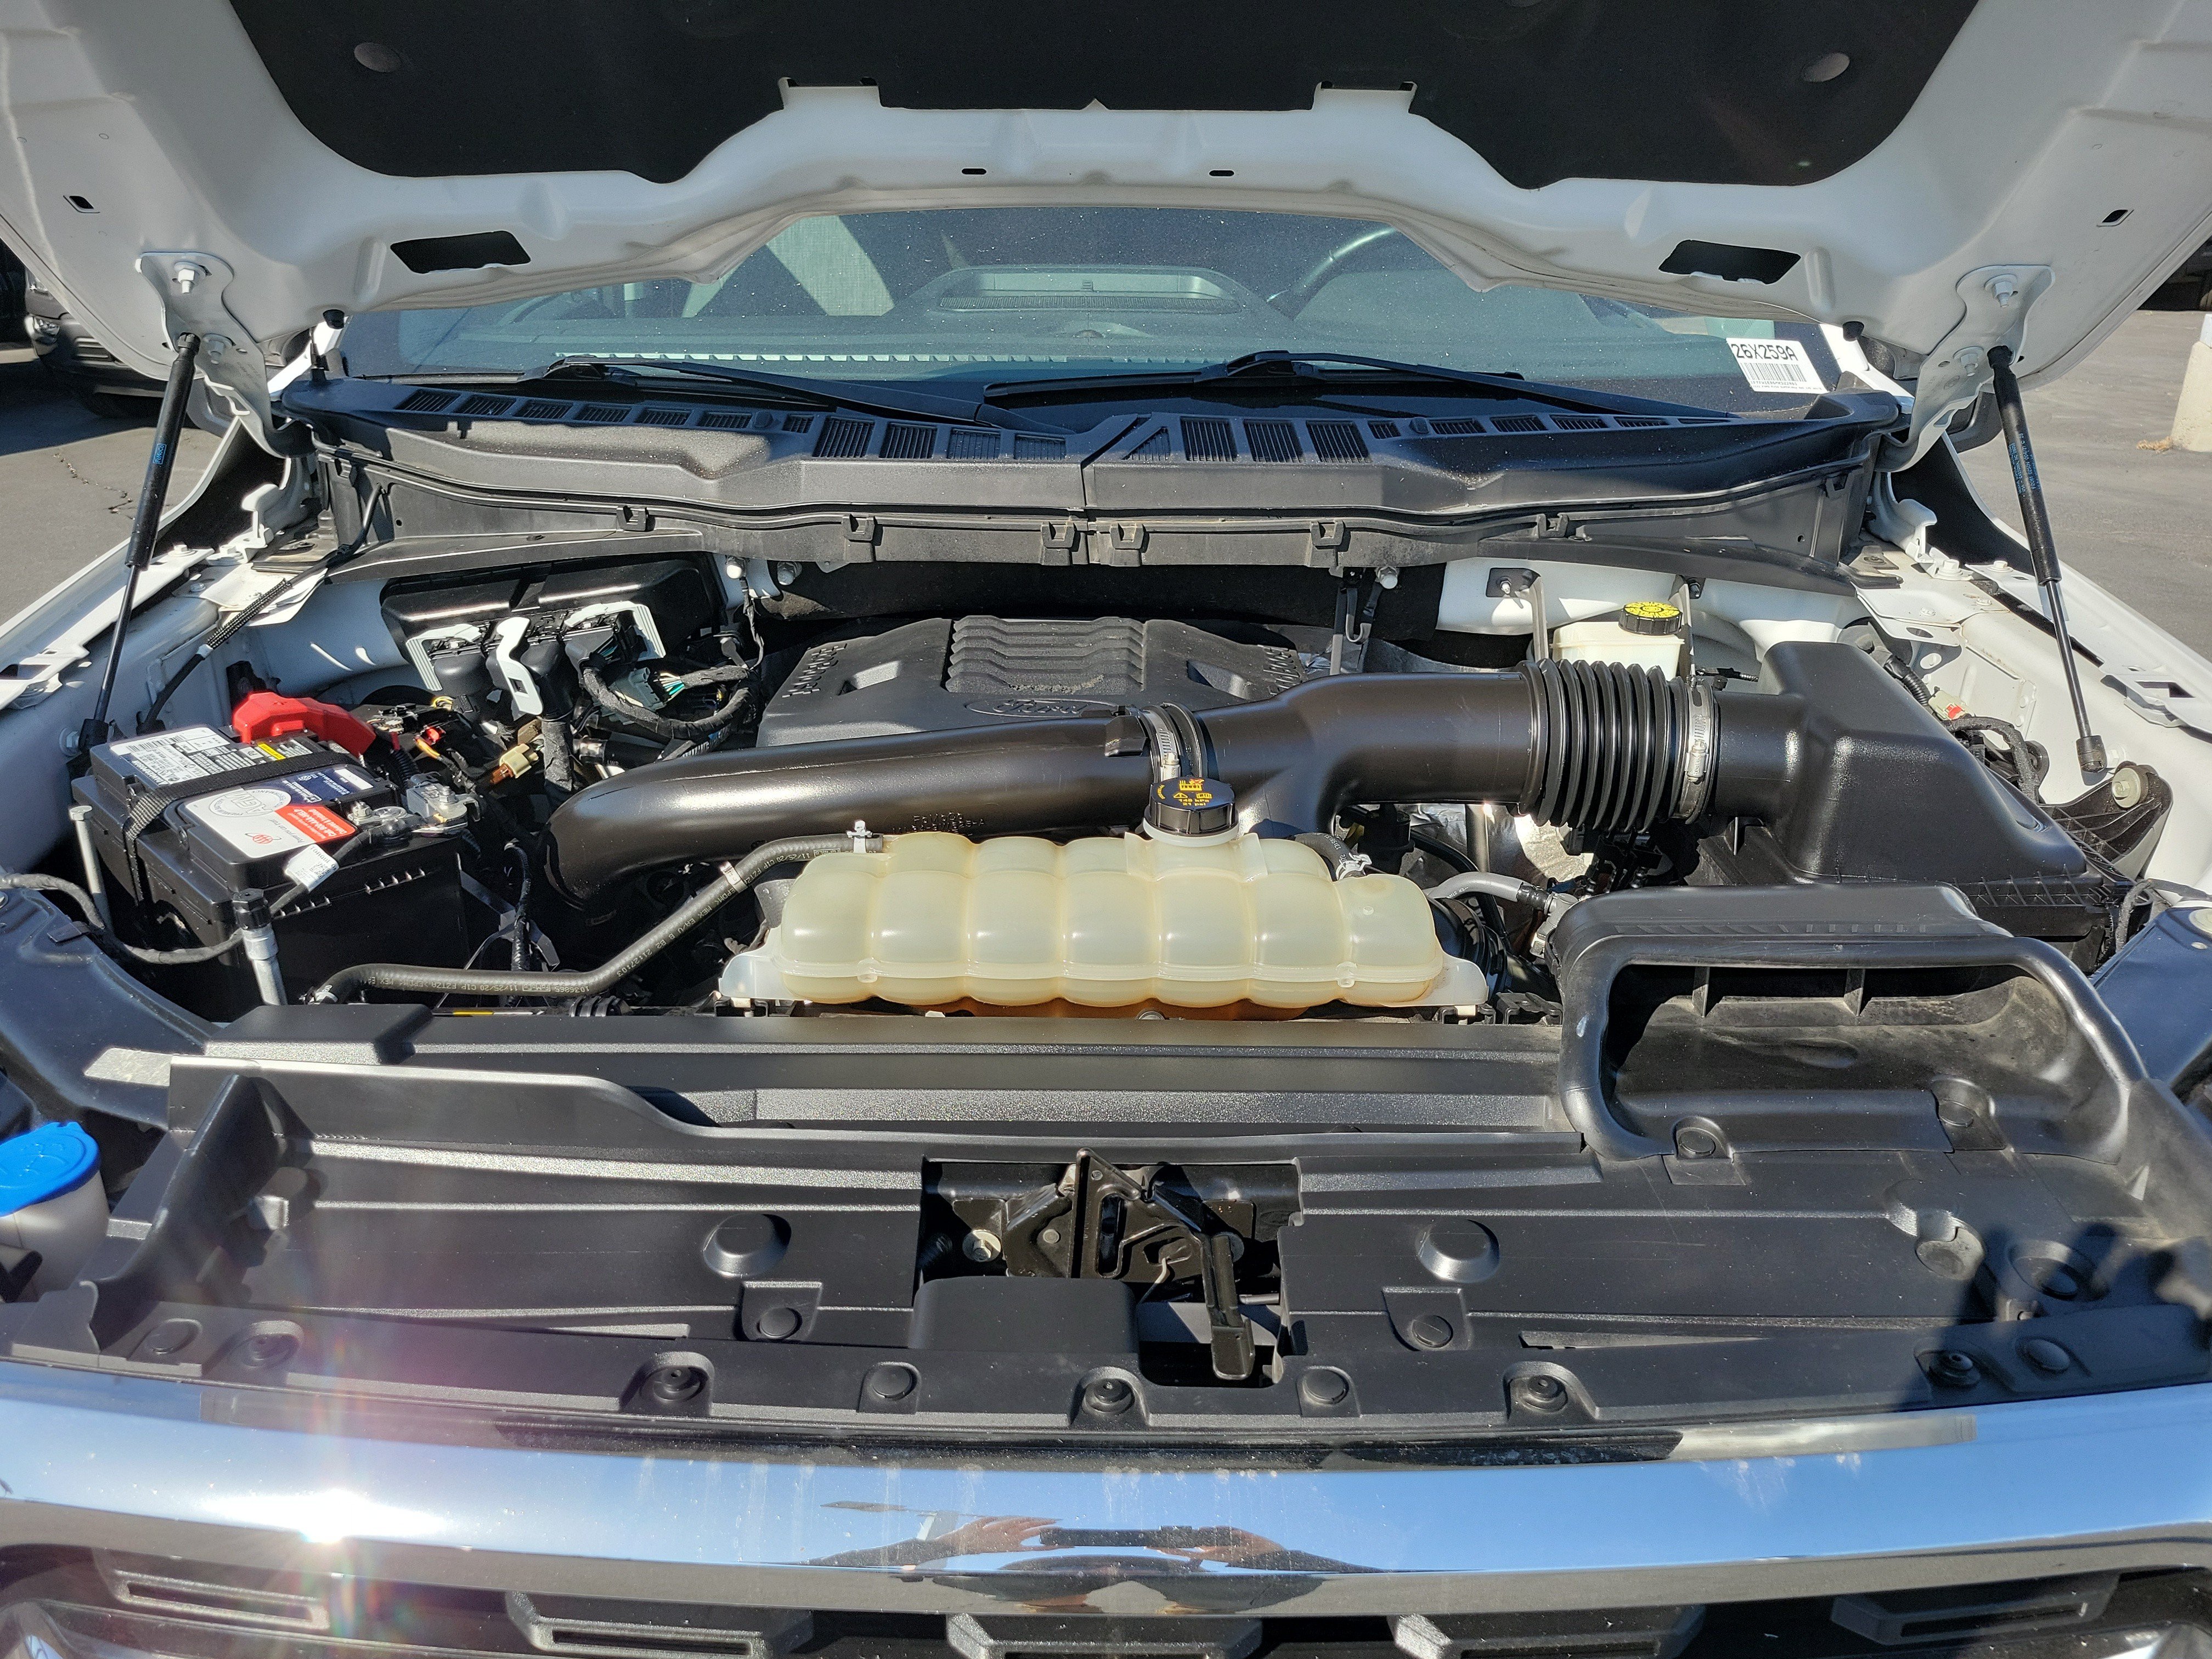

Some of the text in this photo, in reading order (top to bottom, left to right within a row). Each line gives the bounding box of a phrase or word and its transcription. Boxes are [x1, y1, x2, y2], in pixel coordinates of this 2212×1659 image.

[1731, 343, 1798, 361] 26X259A
[992, 698, 1091, 714] Ford
[224, 792, 273, 814] AGM
[763, 858, 775, 869] CIP
[776, 851, 811, 862] 11/25/20
[697, 905, 713, 918] MEX
[677, 917, 696, 933] EA/U
[655, 939, 667, 949] B2
[616, 949, 652, 977] 21:27:03
